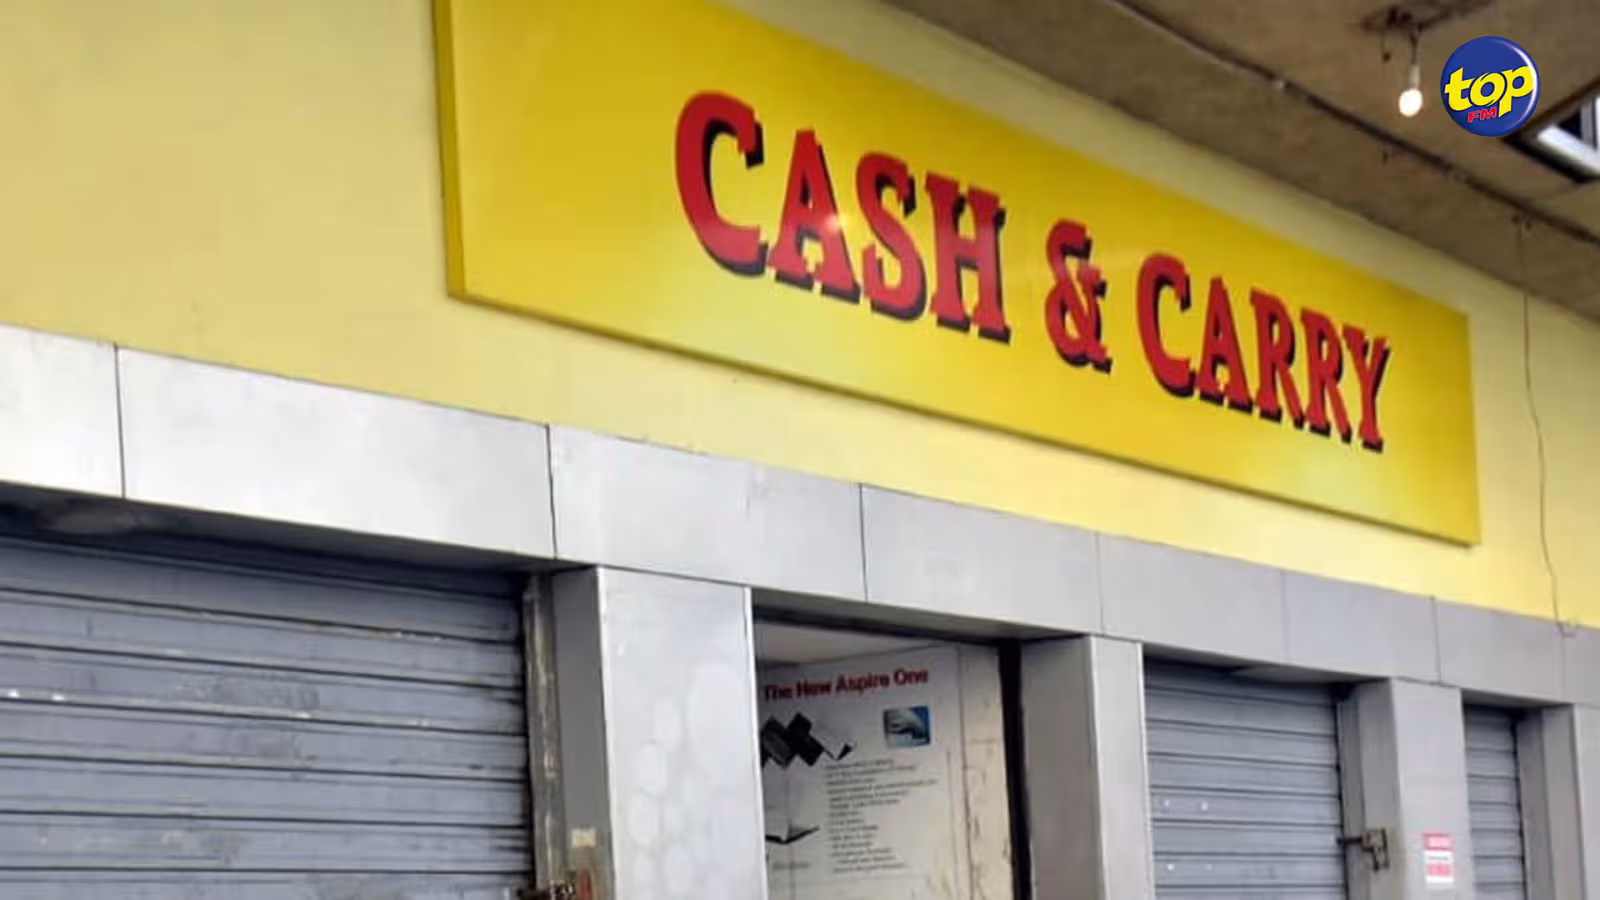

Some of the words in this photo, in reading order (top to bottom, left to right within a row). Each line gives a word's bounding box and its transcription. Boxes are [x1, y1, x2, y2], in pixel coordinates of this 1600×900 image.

[674, 89, 1011, 345] CASH
[1044, 217, 1112, 374] &
[1137, 251, 1390, 453] CARRY
[765, 683, 793, 701] The
[796, 677, 832, 698] New
[836, 673, 890, 696] Aspire
[893, 668, 929, 686] One
